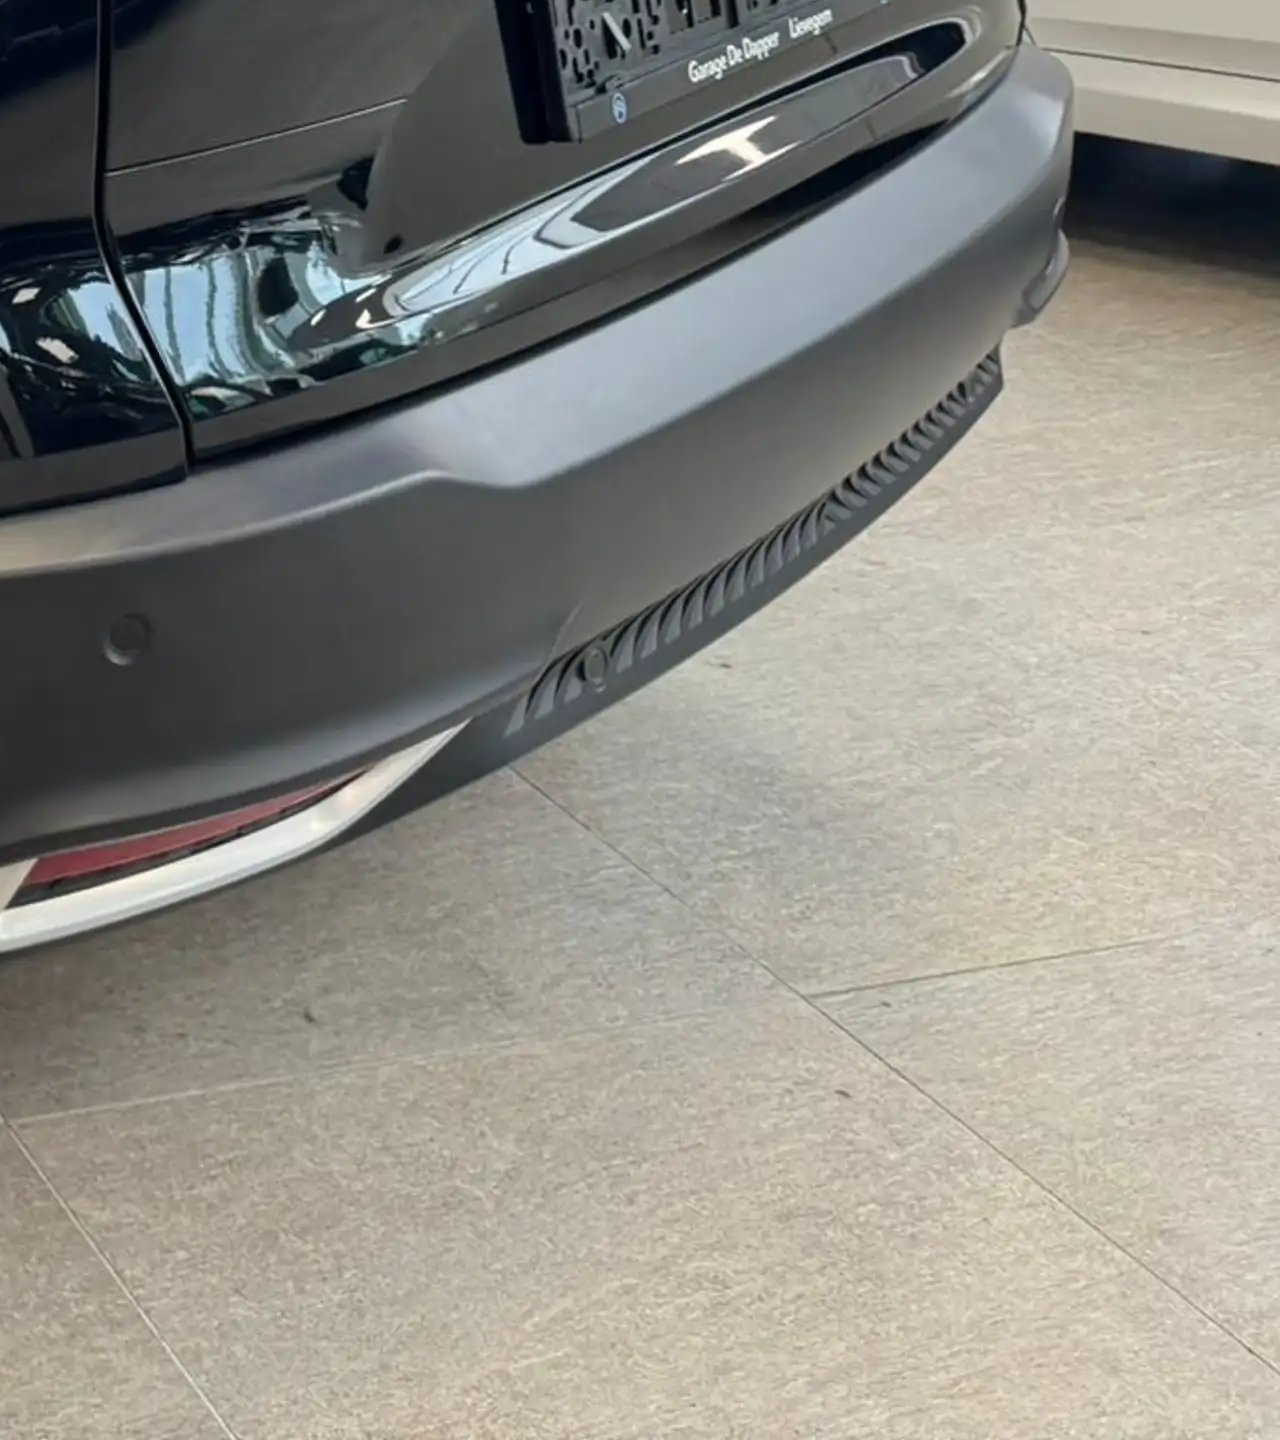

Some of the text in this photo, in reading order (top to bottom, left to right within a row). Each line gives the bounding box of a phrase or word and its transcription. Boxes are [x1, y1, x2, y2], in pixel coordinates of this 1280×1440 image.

[688, 55, 727, 83] Garage
[726, 45, 743, 66] De
[743, 31, 780, 60] Dapper
